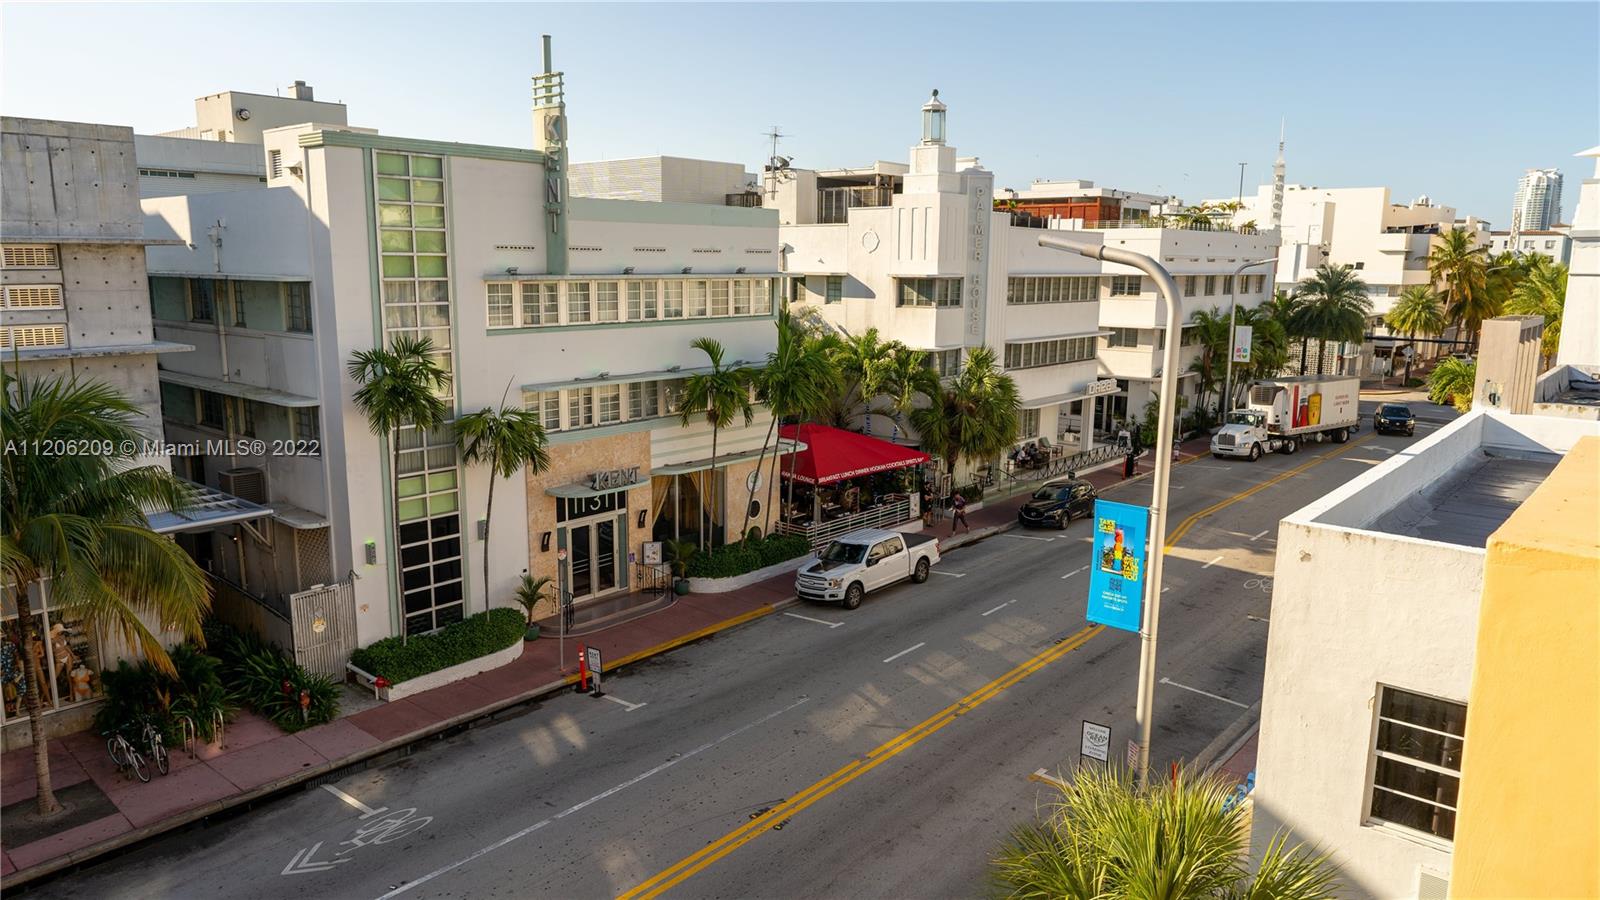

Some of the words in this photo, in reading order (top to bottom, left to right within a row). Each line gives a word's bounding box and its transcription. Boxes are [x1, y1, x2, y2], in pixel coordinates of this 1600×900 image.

[543, 114, 562, 233] KENT
[973, 186, 985, 263] PALMER
[970, 273, 983, 335] HOUSE
[592, 465, 641, 490] KENT
[841, 470, 855, 478] LUNCH
[574, 492, 609, 514] 1131
